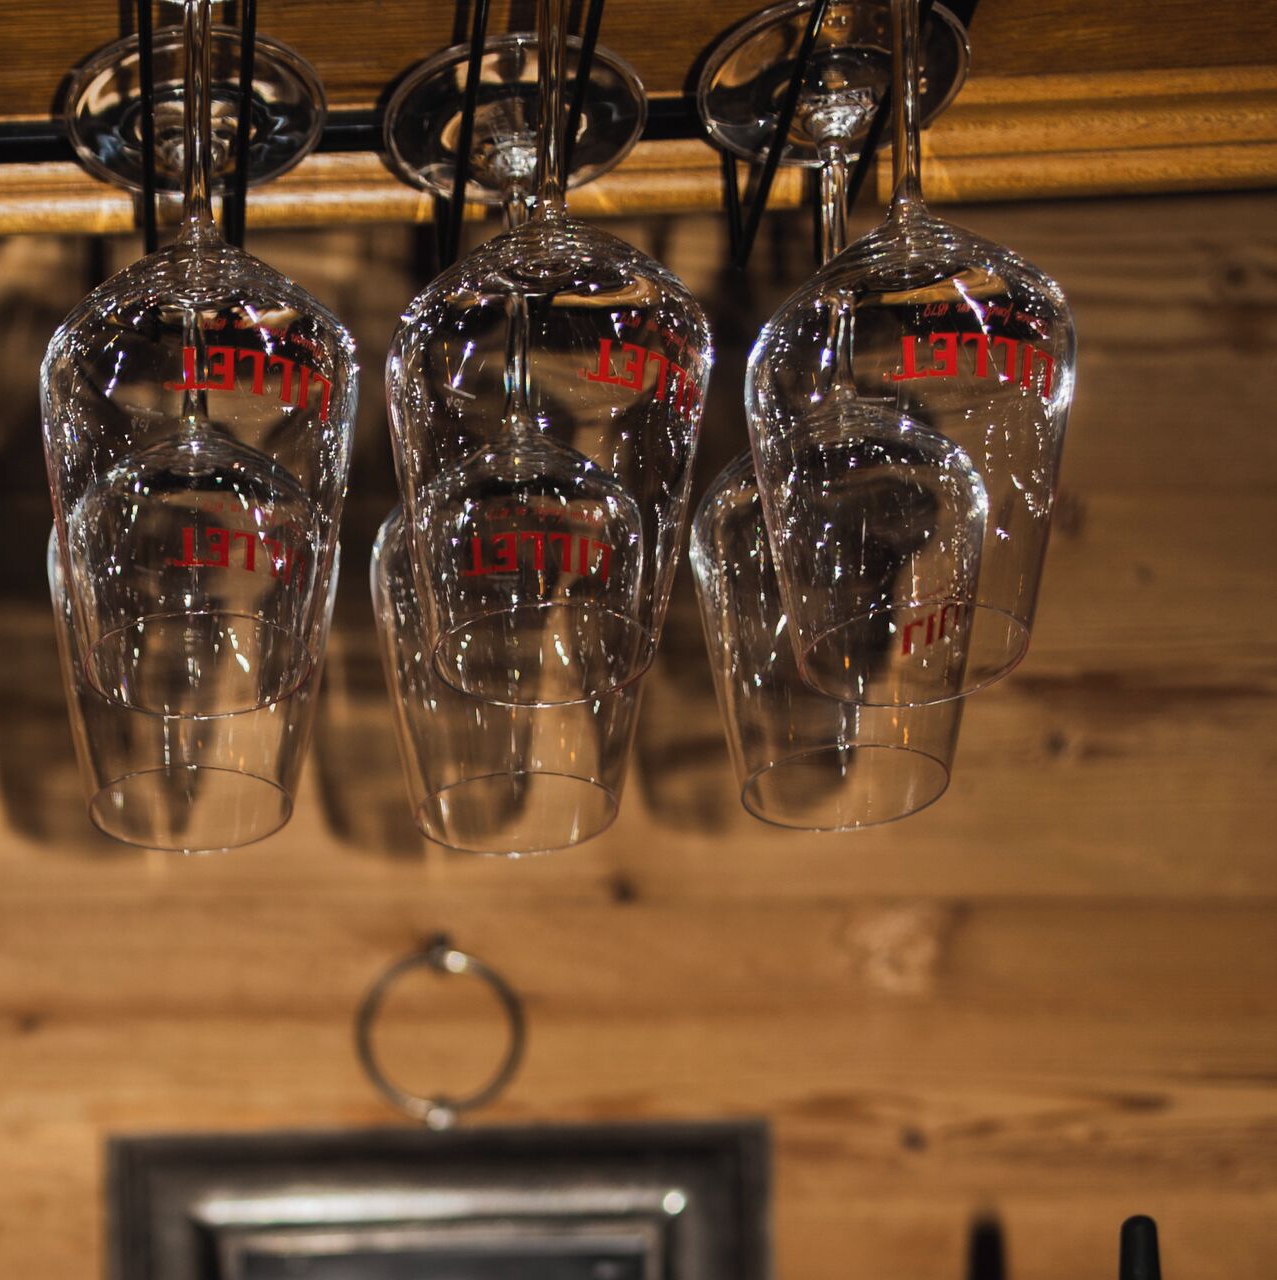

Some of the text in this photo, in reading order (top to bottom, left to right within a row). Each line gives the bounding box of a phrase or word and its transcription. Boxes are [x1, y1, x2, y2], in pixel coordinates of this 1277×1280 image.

[173, 345, 333, 424] LILLET
[891, 332, 1054, 400] LILLET
[457, 530, 611, 584] LILLET
